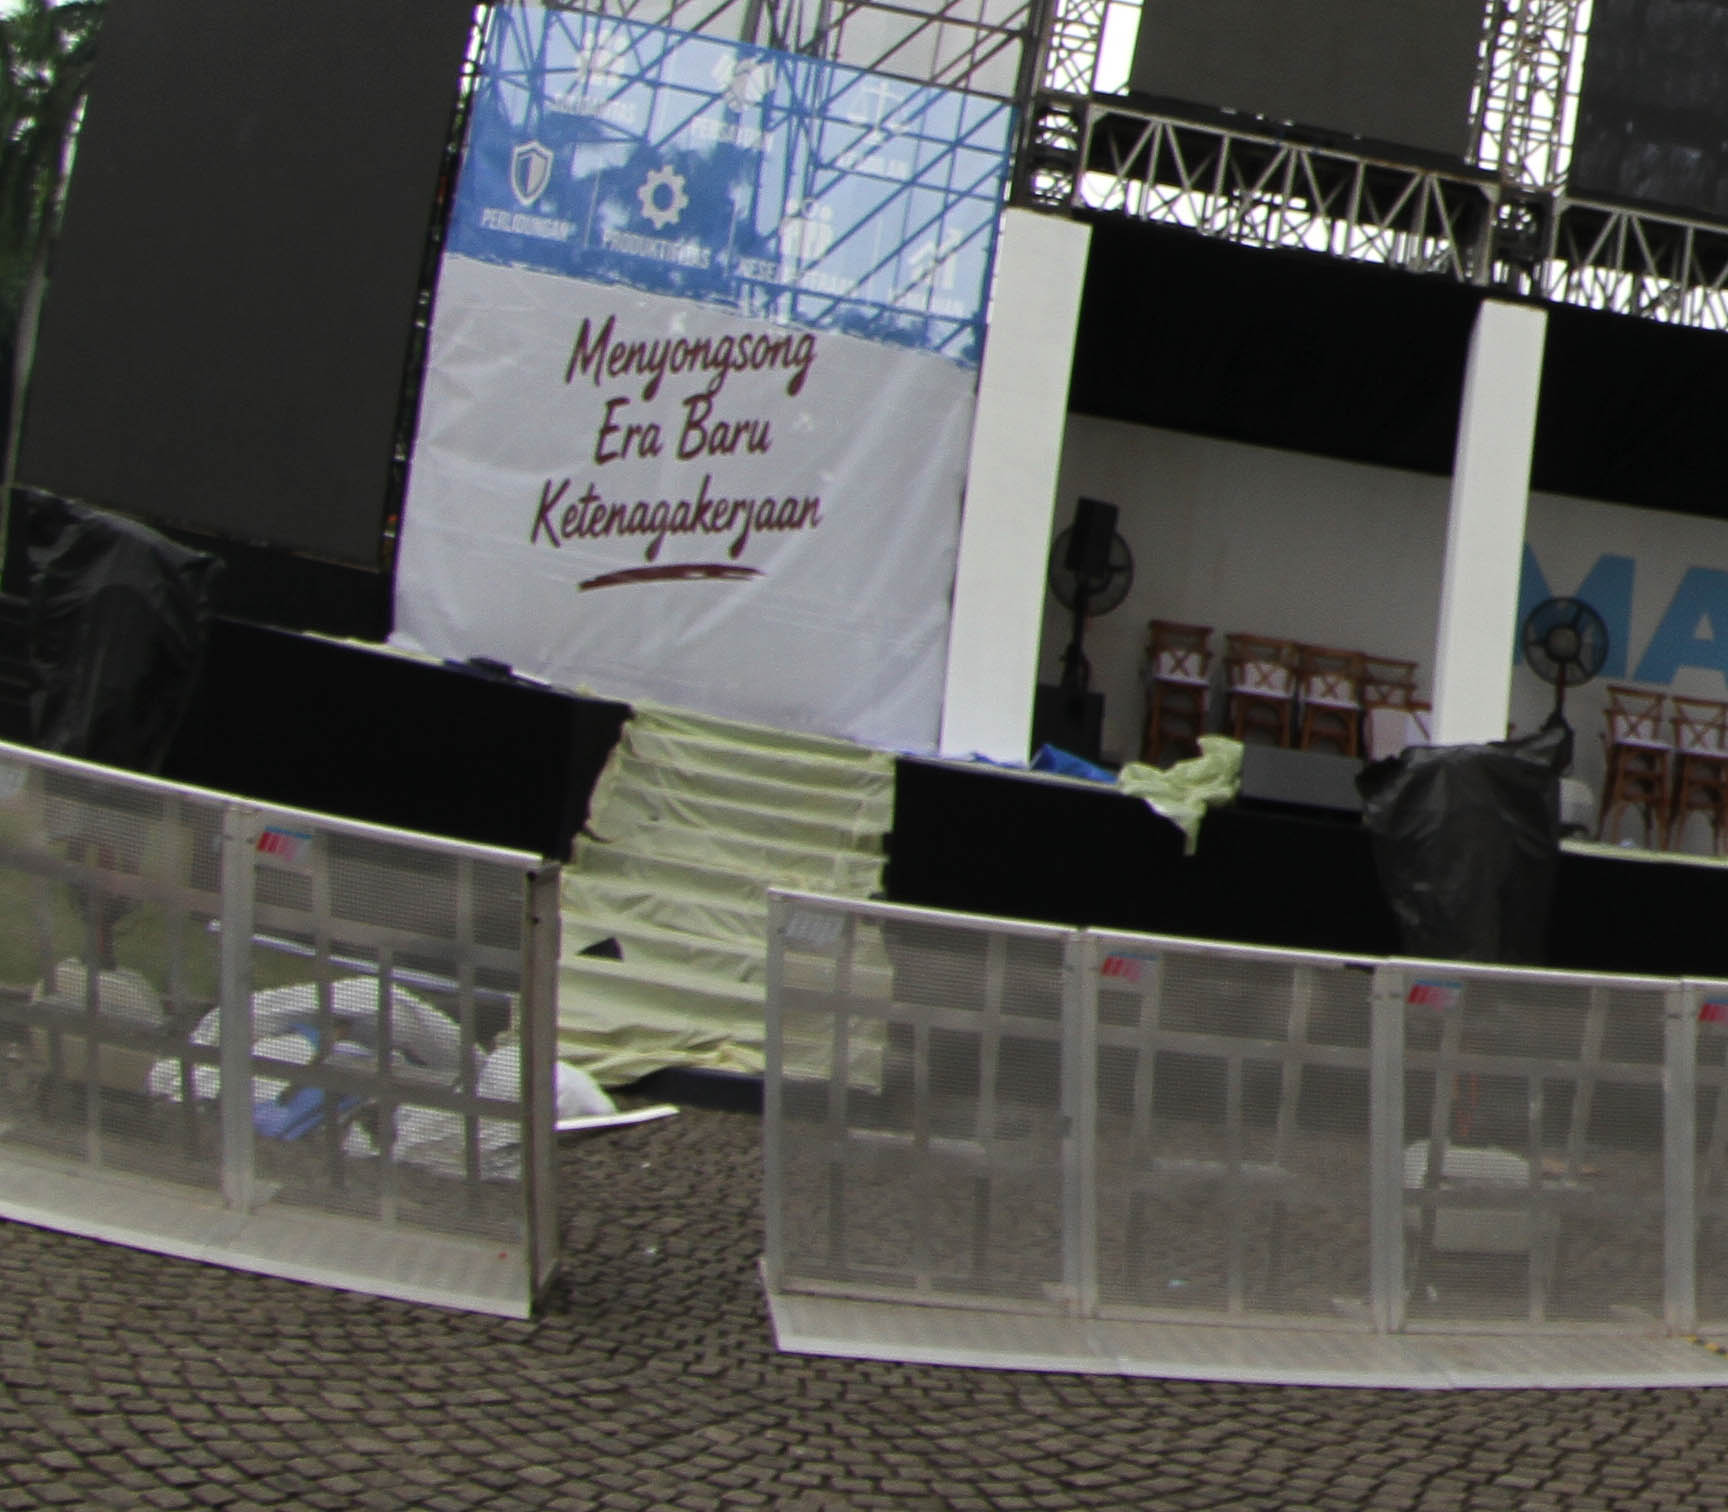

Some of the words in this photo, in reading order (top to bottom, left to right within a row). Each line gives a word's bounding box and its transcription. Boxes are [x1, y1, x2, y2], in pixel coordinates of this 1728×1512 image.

[565, 314, 817, 401] Menyongsong
[594, 396, 663, 465] Era
[676, 392, 772, 460] Baru
[530, 474, 822, 562] Ketenagakerjaan
